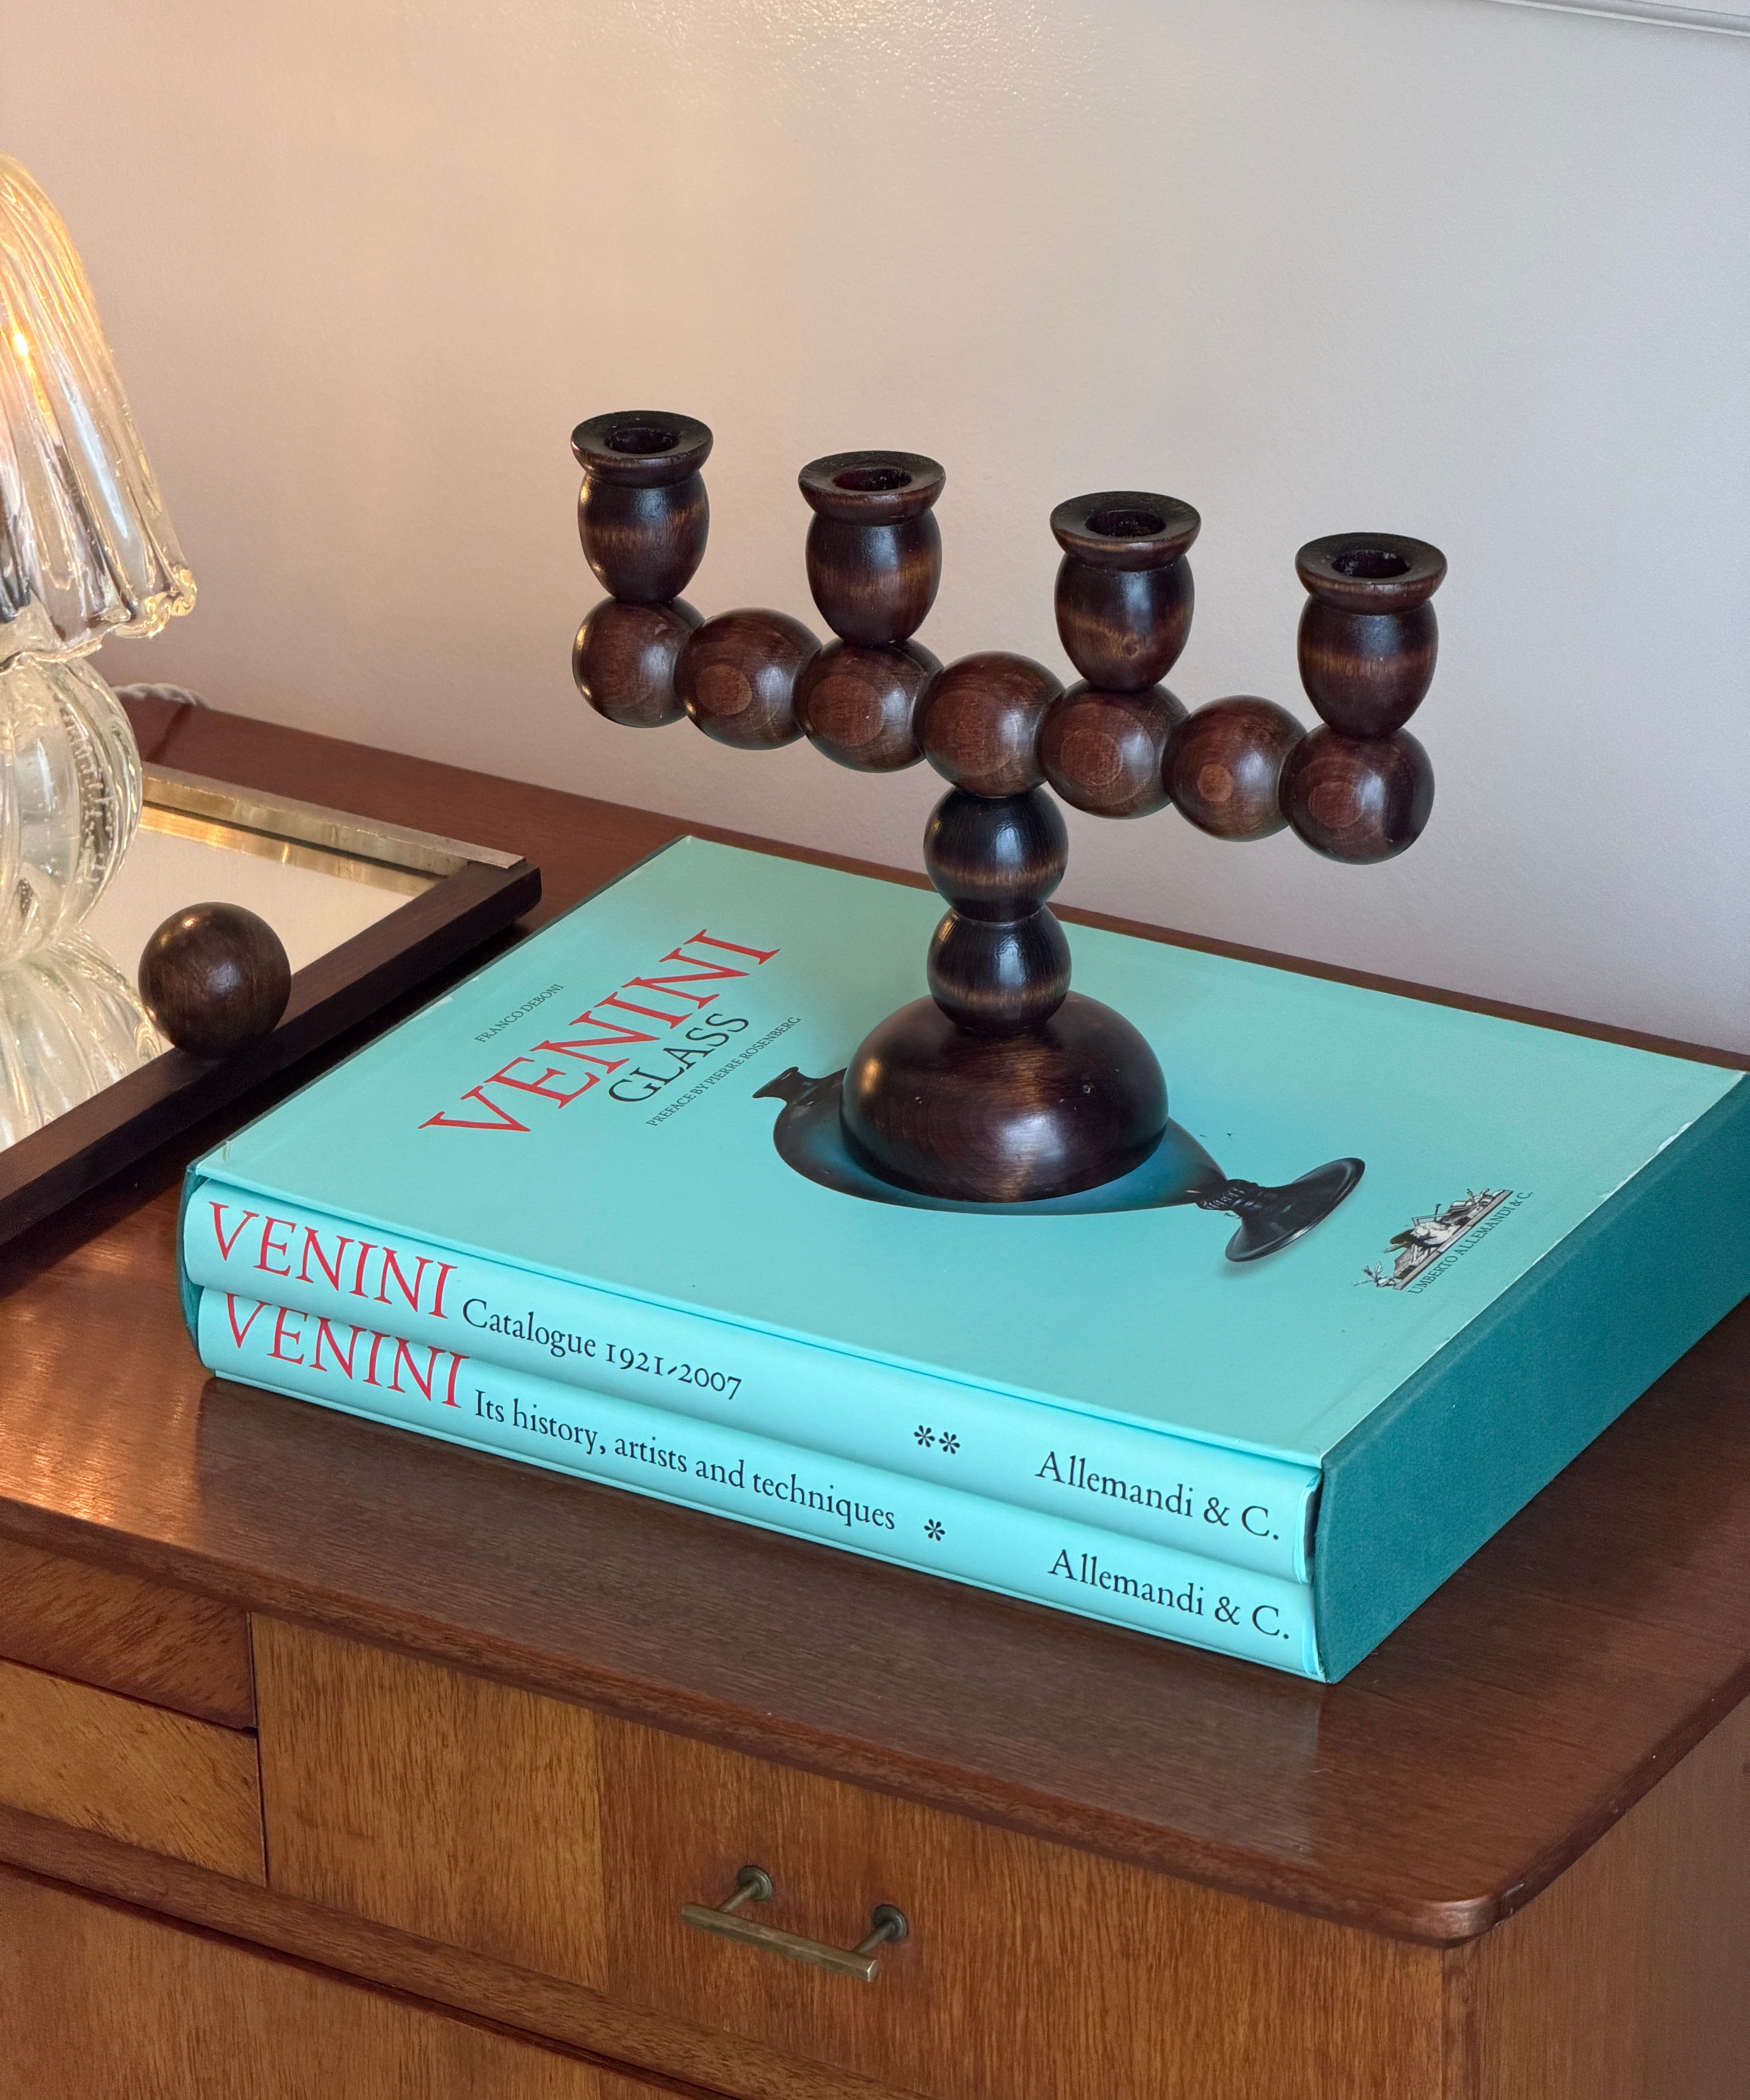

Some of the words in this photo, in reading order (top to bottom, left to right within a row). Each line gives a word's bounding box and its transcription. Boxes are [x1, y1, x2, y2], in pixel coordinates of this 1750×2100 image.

[417, 929, 781, 1133] VENINI
[474, 1011, 524, 1042] FRANCO
[520, 984, 565, 1012] DEBONI
[608, 1013, 749, 1103] GLASS
[645, 1093, 696, 1126] PREFACE
[690, 1083, 709, 1095] BY
[703, 1058, 745, 1085] PIERRE
[738, 1016, 802, 1060] ROSENBERG
[209, 1201, 458, 1319] VENINI
[462, 1298, 596, 1358] Catalogue
[1407, 1256, 1458, 1294] UMBERTO
[1453, 1206, 1516, 1256] ALLEMANDI
[225, 1293, 470, 1408] VENINI
[474, 1390, 504, 1422] Its
[513, 1399, 606, 1455] history,
[614, 1436, 687, 1472] artists
[695, 1459, 745, 1489] and
[753, 1474, 895, 1530] techniques
[1035, 1451, 1193, 1517] Allemandi
[1203, 1497, 1230, 1527] &
[1241, 1505, 1279, 1540] C.
[1048, 1549, 1204, 1616] Allemandi
[1214, 1596, 1240, 1626] &
[1252, 1605, 1289, 1640] C.
